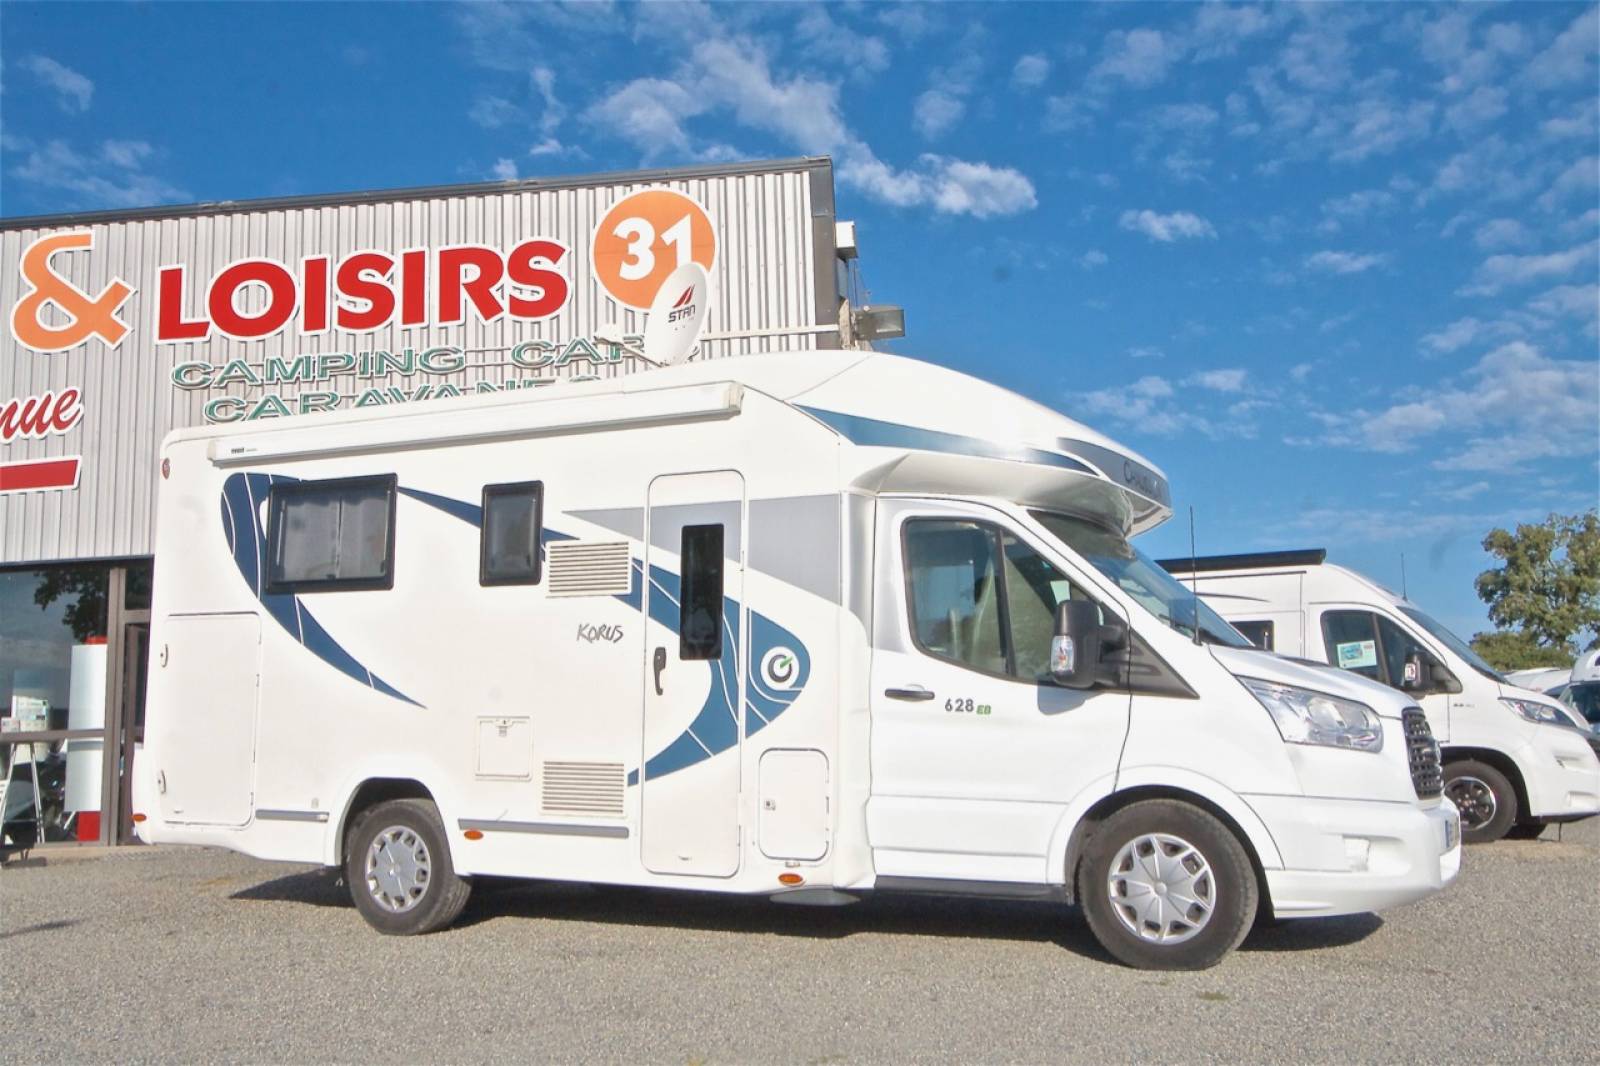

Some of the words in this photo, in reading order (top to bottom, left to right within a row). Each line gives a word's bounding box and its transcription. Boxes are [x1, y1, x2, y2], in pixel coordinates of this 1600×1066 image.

[612, 213, 693, 281] 31
[11, 232, 134, 352] &
[157, 240, 568, 342] LOISIRS
[172, 347, 466, 390] CAMPING
[576, 623, 624, 644] KORUS
[944, 698, 974, 712] 628
